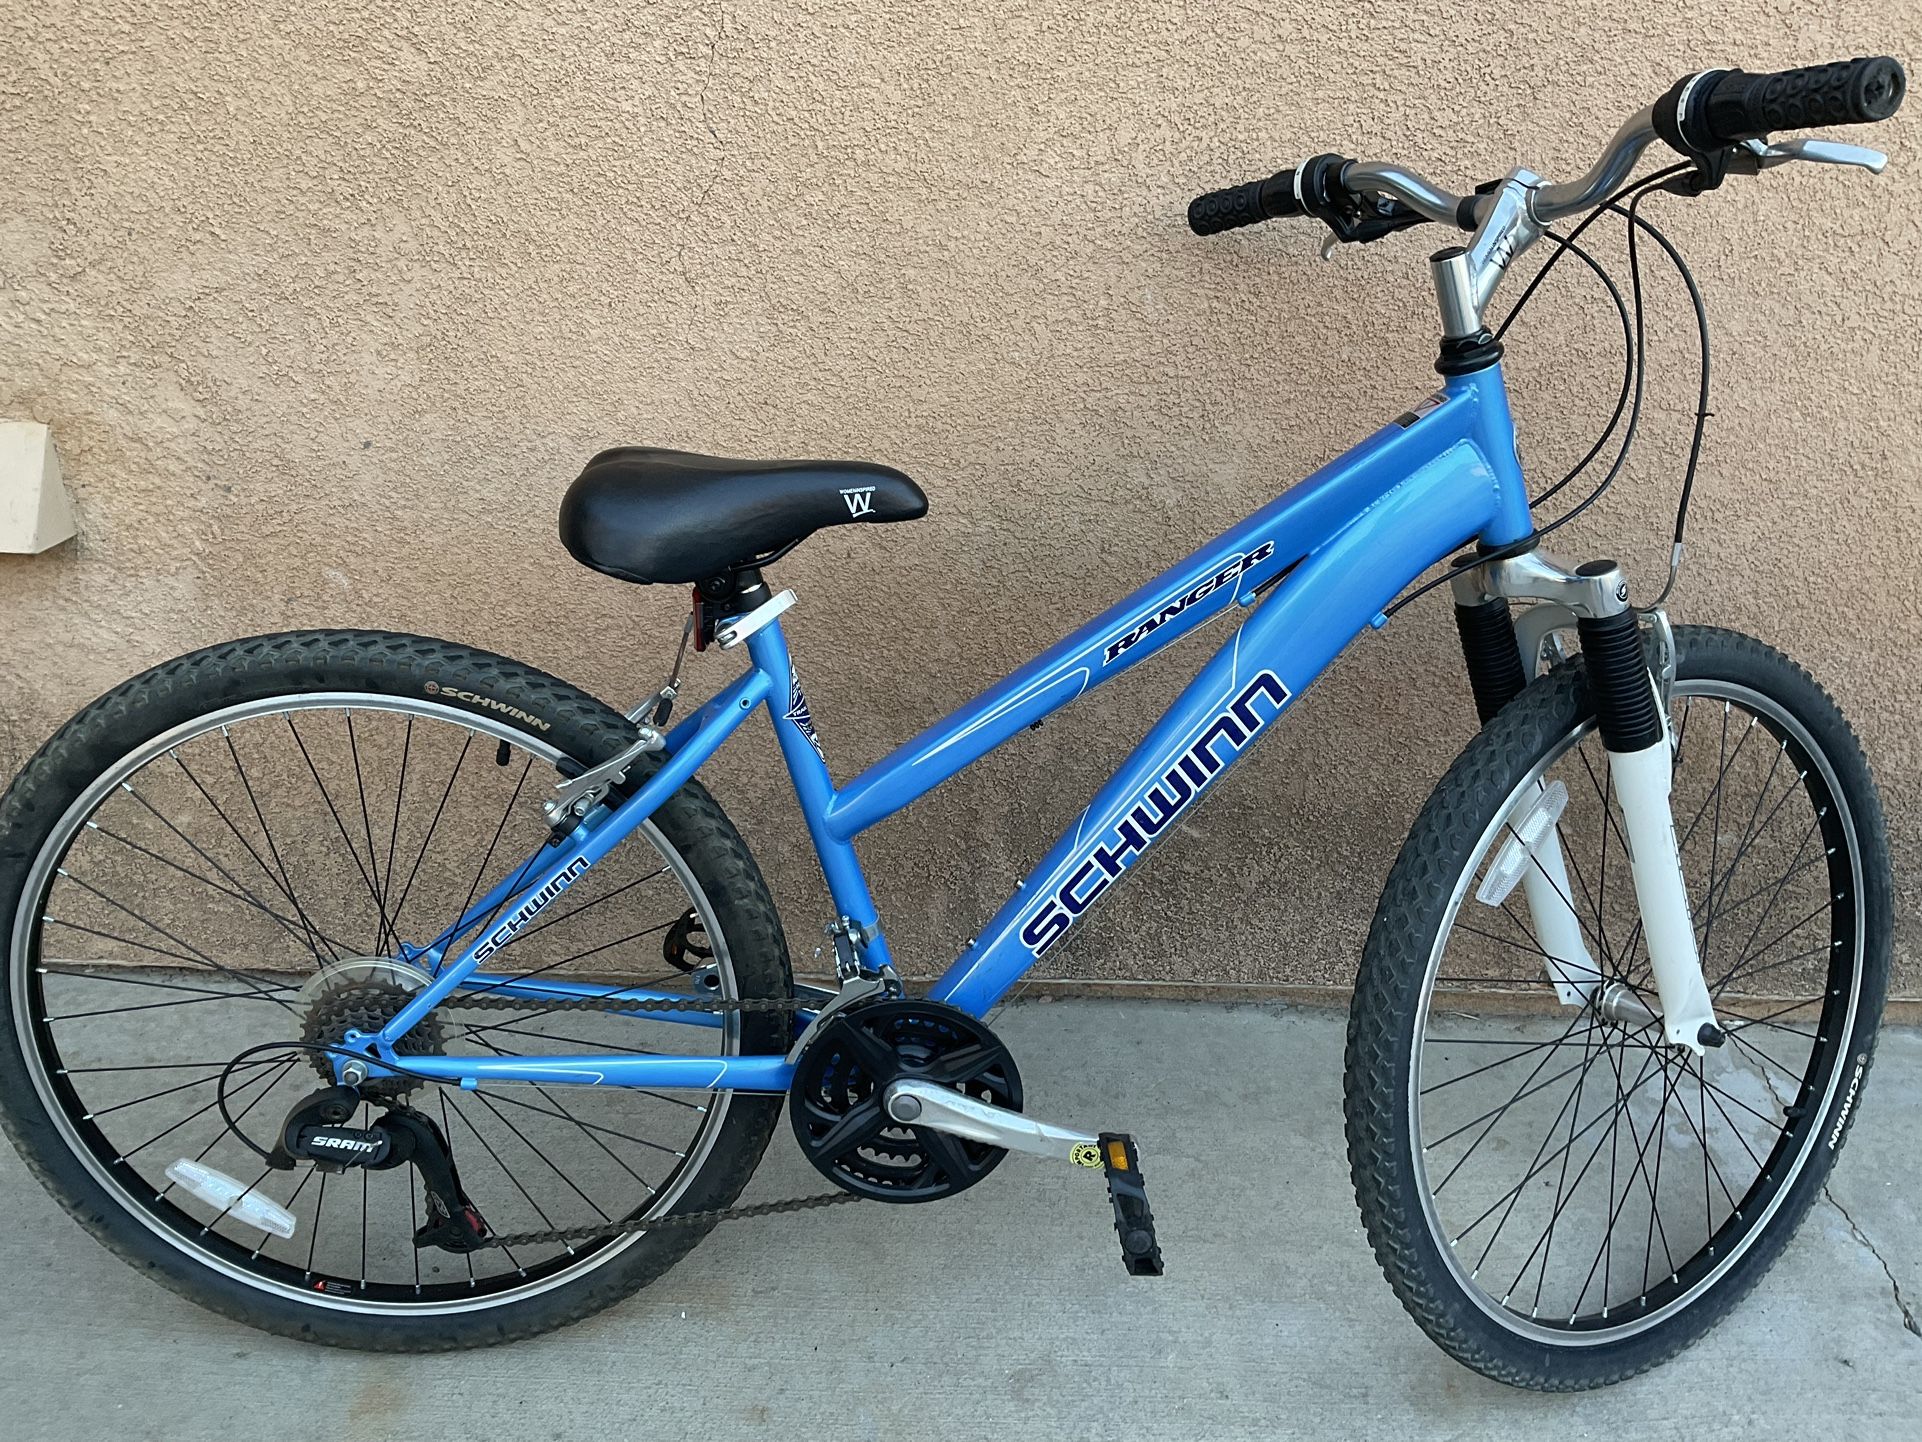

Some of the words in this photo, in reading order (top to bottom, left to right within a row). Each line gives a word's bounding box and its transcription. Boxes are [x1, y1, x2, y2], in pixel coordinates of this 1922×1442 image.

[1103, 541, 1274, 667] RANGER
[440, 686, 551, 732] SCHWINN
[1020, 670, 1292, 958] SCHWINN
[473, 855, 591, 965] SCHWINN
[311, 1136, 376, 1152] SRAM
[1828, 1064, 1863, 1150] SCHWINN
